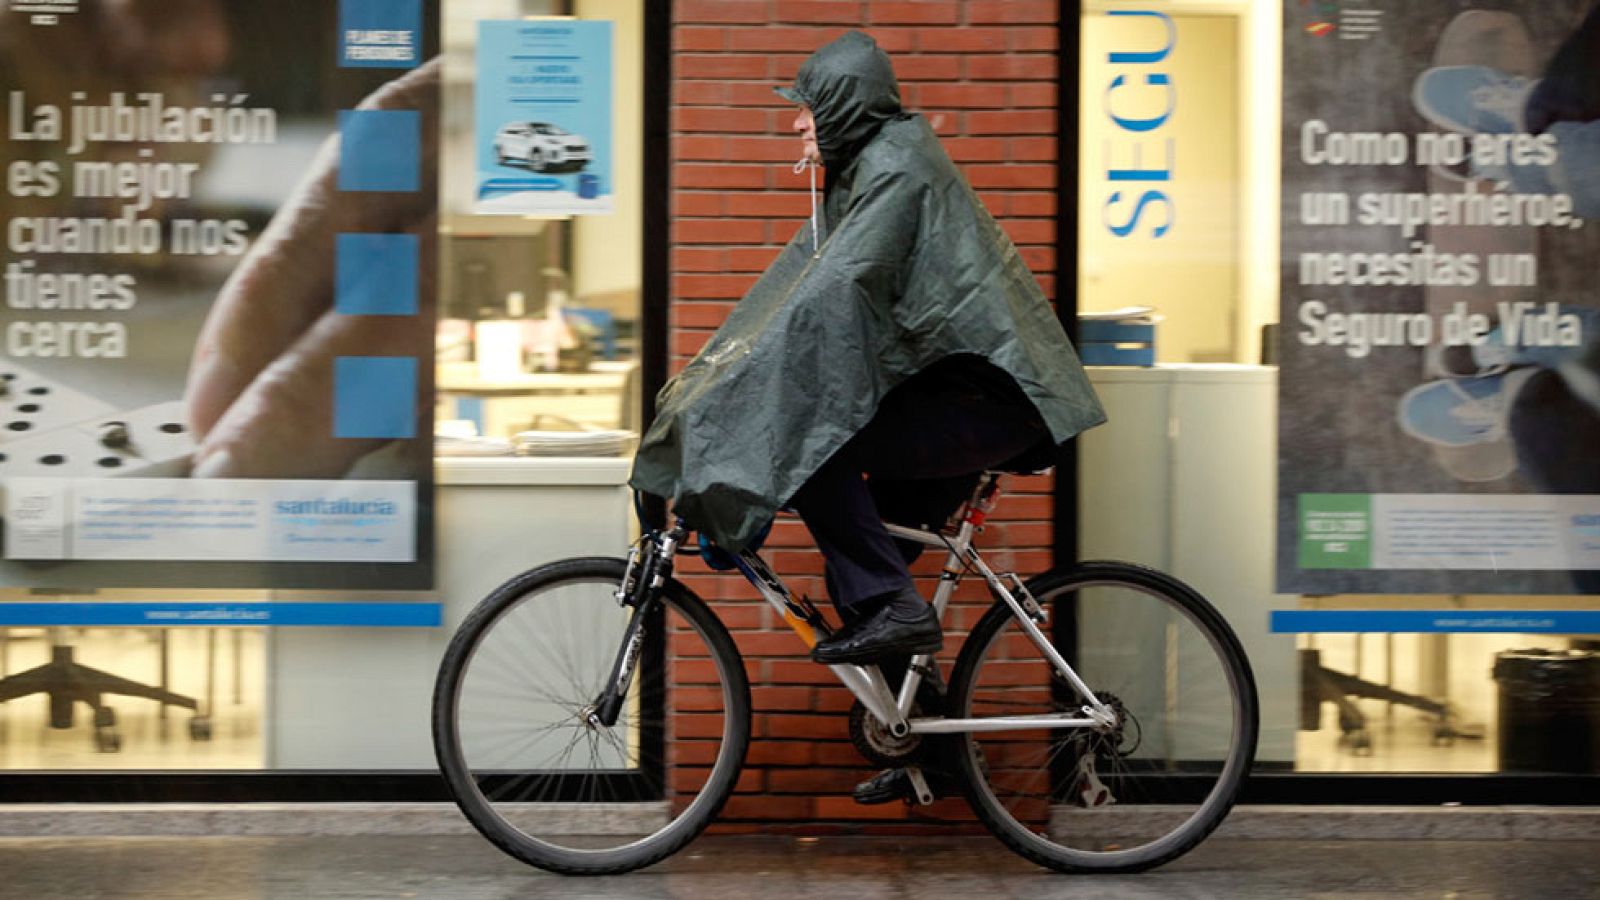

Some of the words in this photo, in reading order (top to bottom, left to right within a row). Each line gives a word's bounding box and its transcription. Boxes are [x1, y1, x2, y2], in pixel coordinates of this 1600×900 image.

[9, 91, 61, 142] La
[68, 92, 276, 154] jubilación
[1103, 10, 1177, 238] SEGU
[1302, 119, 1408, 166] Como
[1416, 132, 1464, 166] no
[1471, 132, 1557, 166] eres
[8, 160, 60, 197] es
[74, 150, 199, 211] mejor
[8, 206, 161, 255] cuando
[170, 219, 248, 255] nos
[1301, 193, 1348, 225] un
[1358, 181, 1583, 237] superhéroe,
[4, 260, 137, 310] tienes
[1300, 241, 1480, 286] necesitas
[1488, 254, 1536, 286] un
[7, 321, 127, 358] cerca
[1299, 301, 1432, 358] Seguro
[1441, 302, 1490, 346] de
[1497, 302, 1582, 346] Vida
